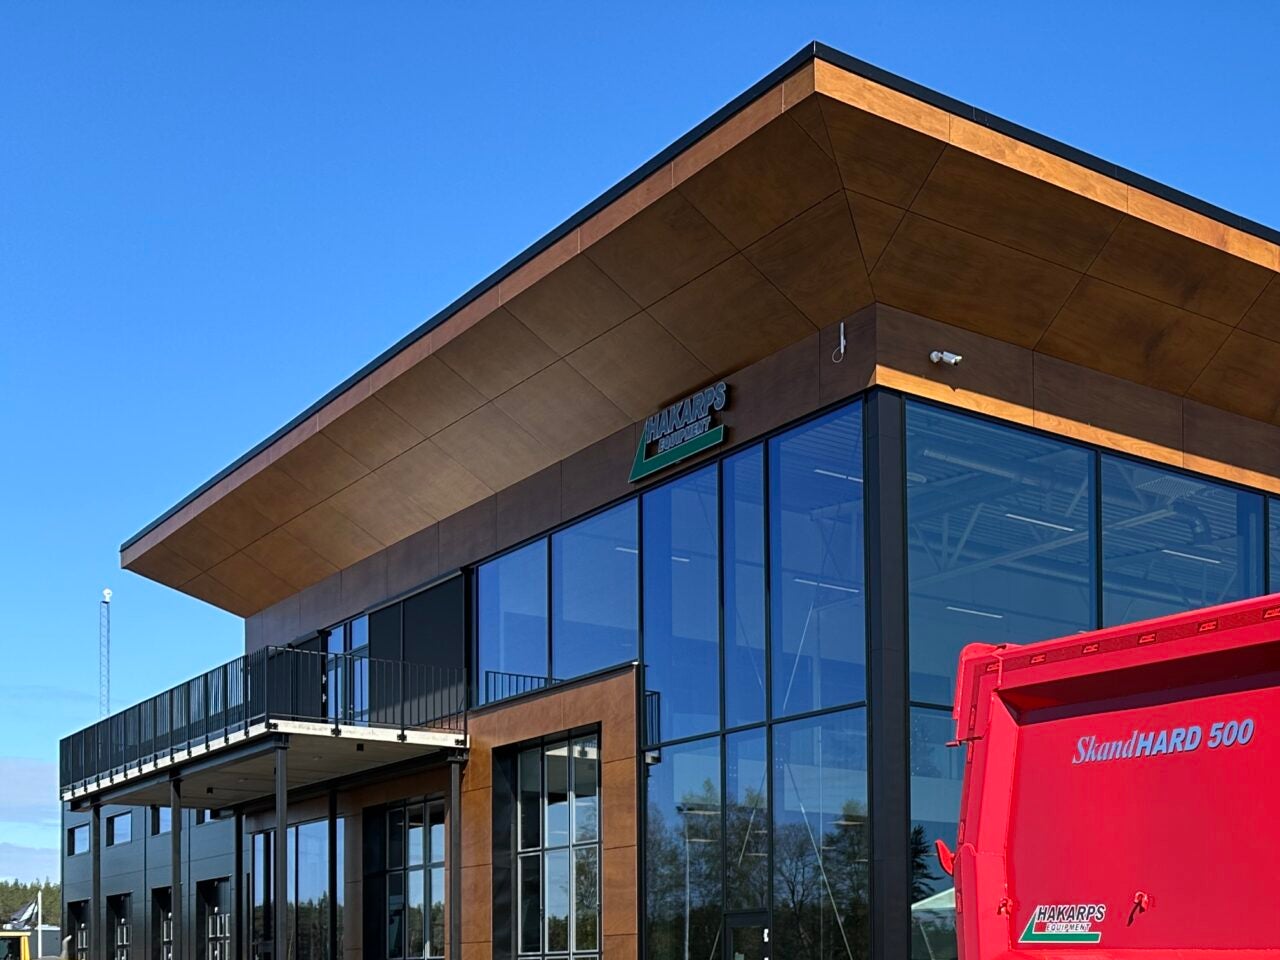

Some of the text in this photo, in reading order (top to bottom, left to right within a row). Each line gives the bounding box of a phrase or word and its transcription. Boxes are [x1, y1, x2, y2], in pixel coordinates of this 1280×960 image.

[645, 381, 727, 444] HAKARPS
[658, 415, 711, 453] EQUIPMENT
[1072, 718, 1255, 765] SkandHARD 500
[1036, 904, 1106, 922] HAKARPS
[1046, 923, 1091, 932] EQUIPMENT
